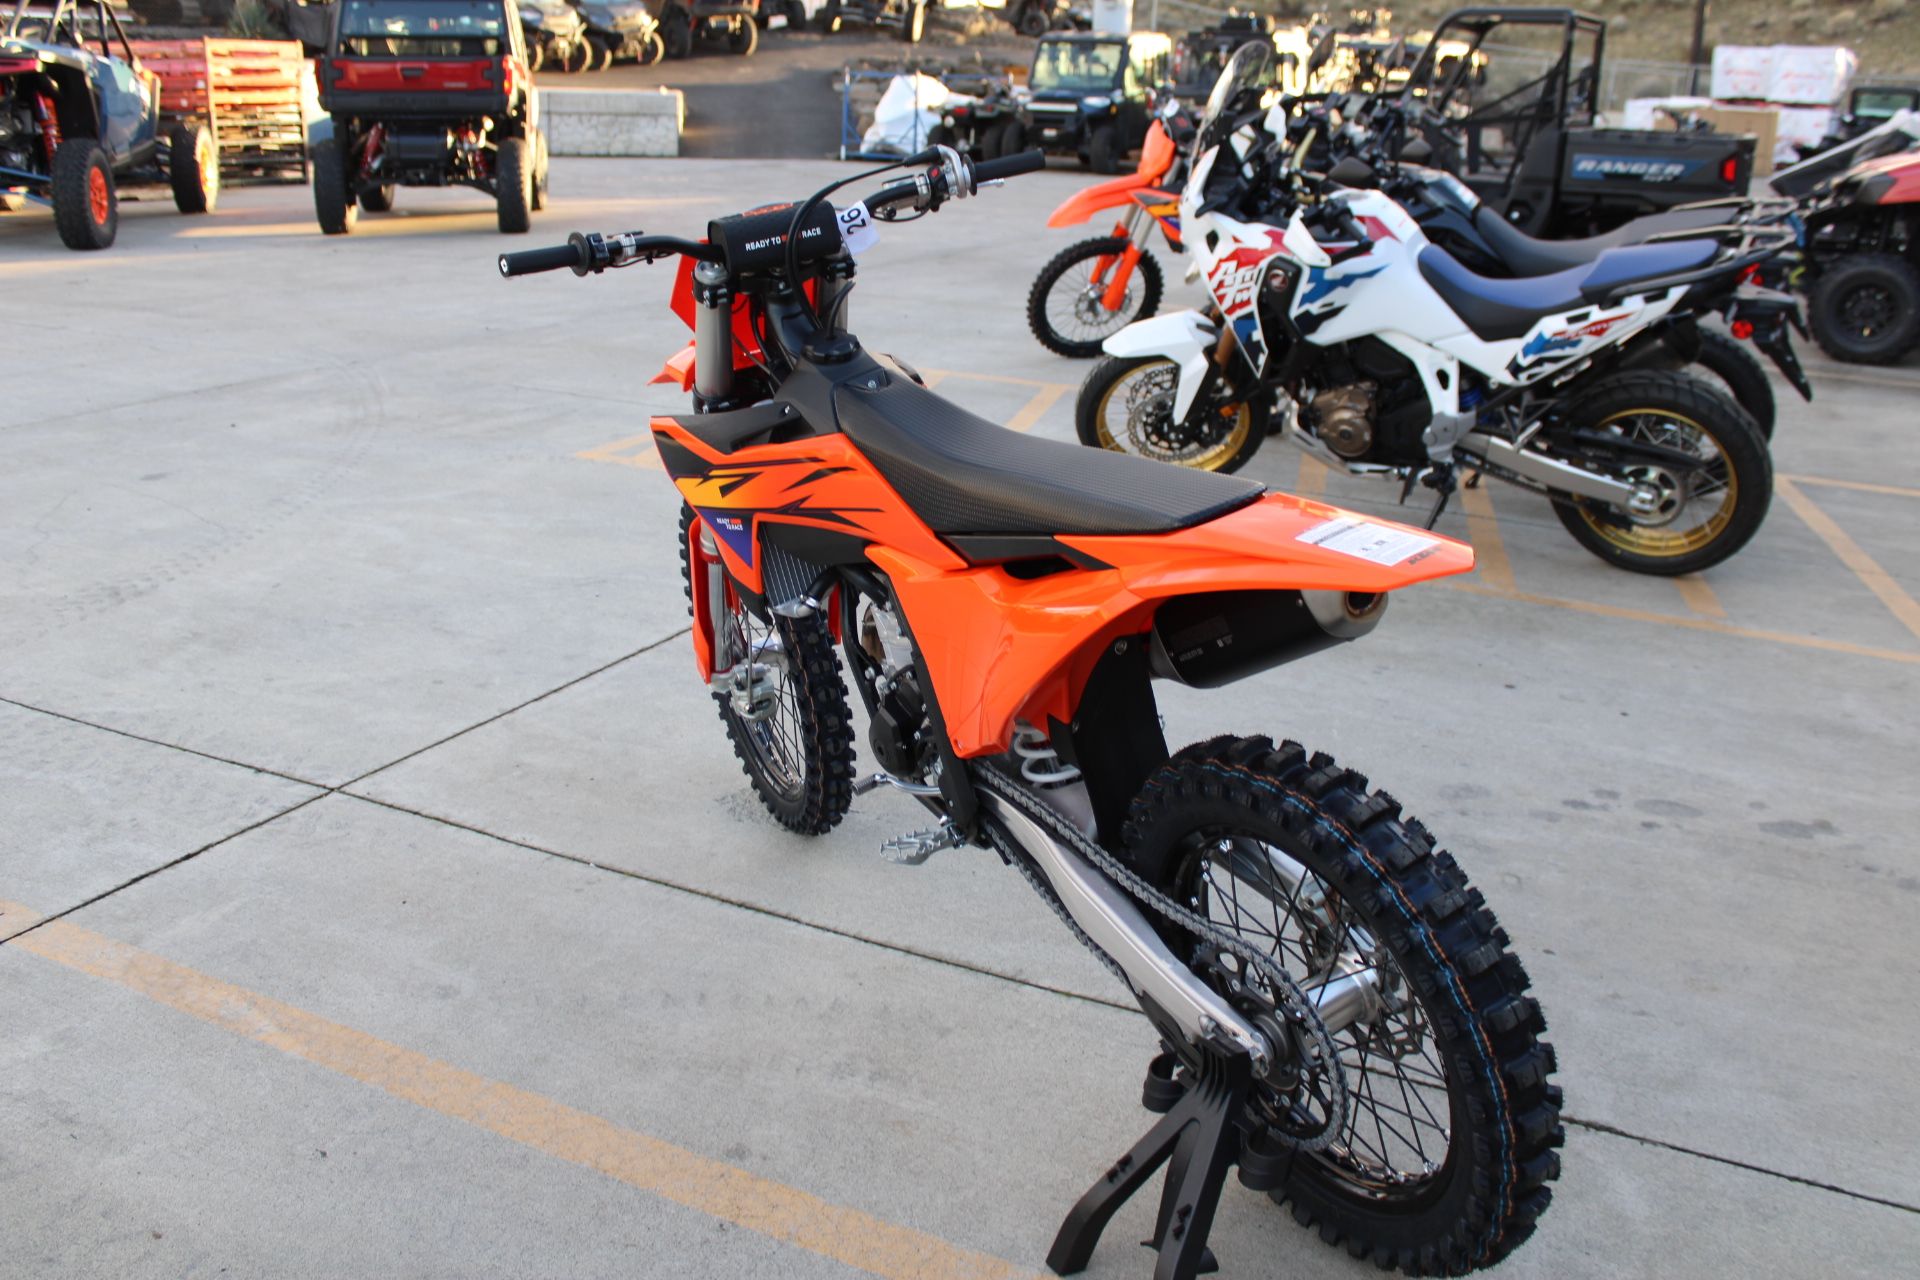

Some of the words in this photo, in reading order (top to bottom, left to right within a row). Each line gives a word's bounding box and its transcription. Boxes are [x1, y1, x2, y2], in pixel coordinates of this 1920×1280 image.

[1577, 160, 1685, 176] RANGER
[840, 207, 867, 235] 26
[745, 238, 770, 251] READY
[771, 236, 782, 246] TO
[801, 226, 822, 239] RACE
